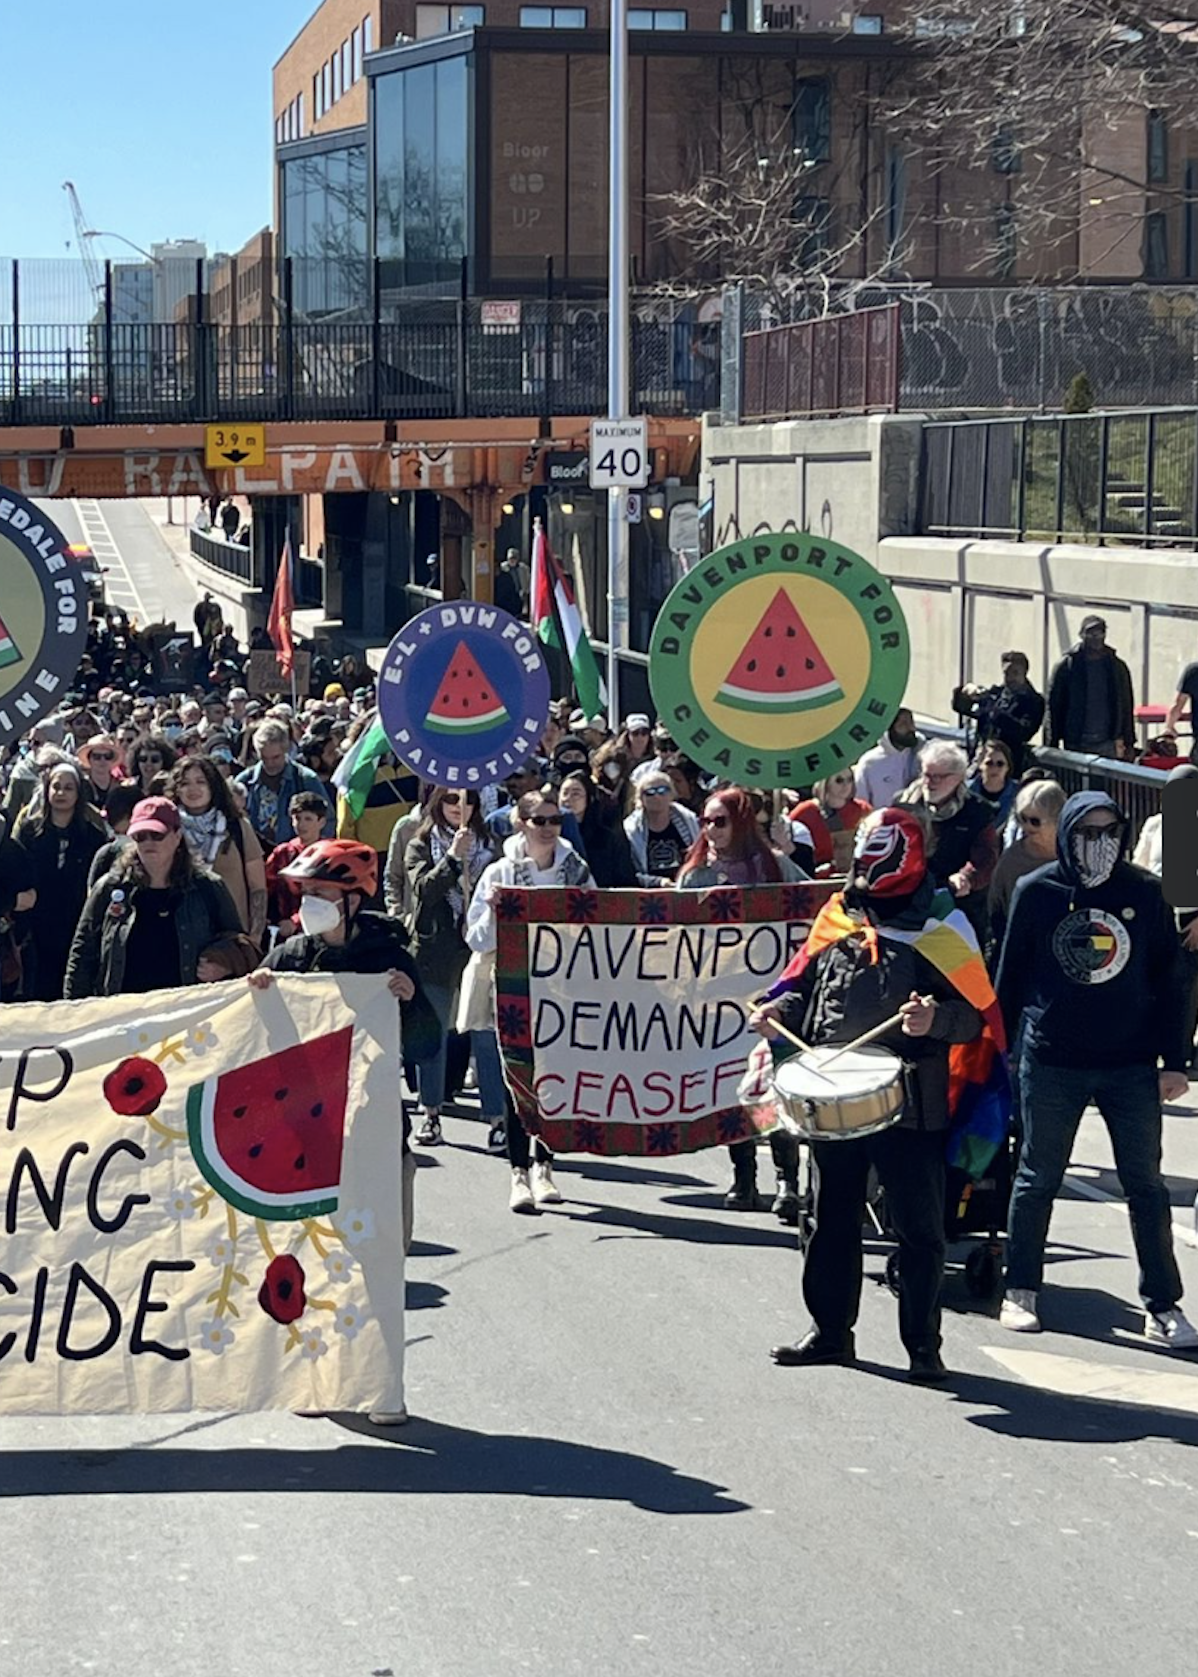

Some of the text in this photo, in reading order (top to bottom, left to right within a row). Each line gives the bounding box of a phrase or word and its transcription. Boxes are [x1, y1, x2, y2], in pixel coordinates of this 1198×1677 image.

[503, 142, 549, 157] Bloor
[595, 428, 642, 437] MAXIMUM
[595, 448, 641, 477] 40
[54, 578, 77, 635] FOR
[660, 543, 900, 655] DAVENPORT FOR
[384, 640, 417, 685] E-L
[440, 606, 497, 629] DVW
[501, 622, 541, 673] FOR
[395, 718, 539, 782] PALESTINE
[673, 698, 888, 778] CEASEFIRE
[531, 922, 815, 980] DAVENPOR
[534, 999, 757, 1051] DEMAND
[533, 1051, 769, 1120] CEASEFI
